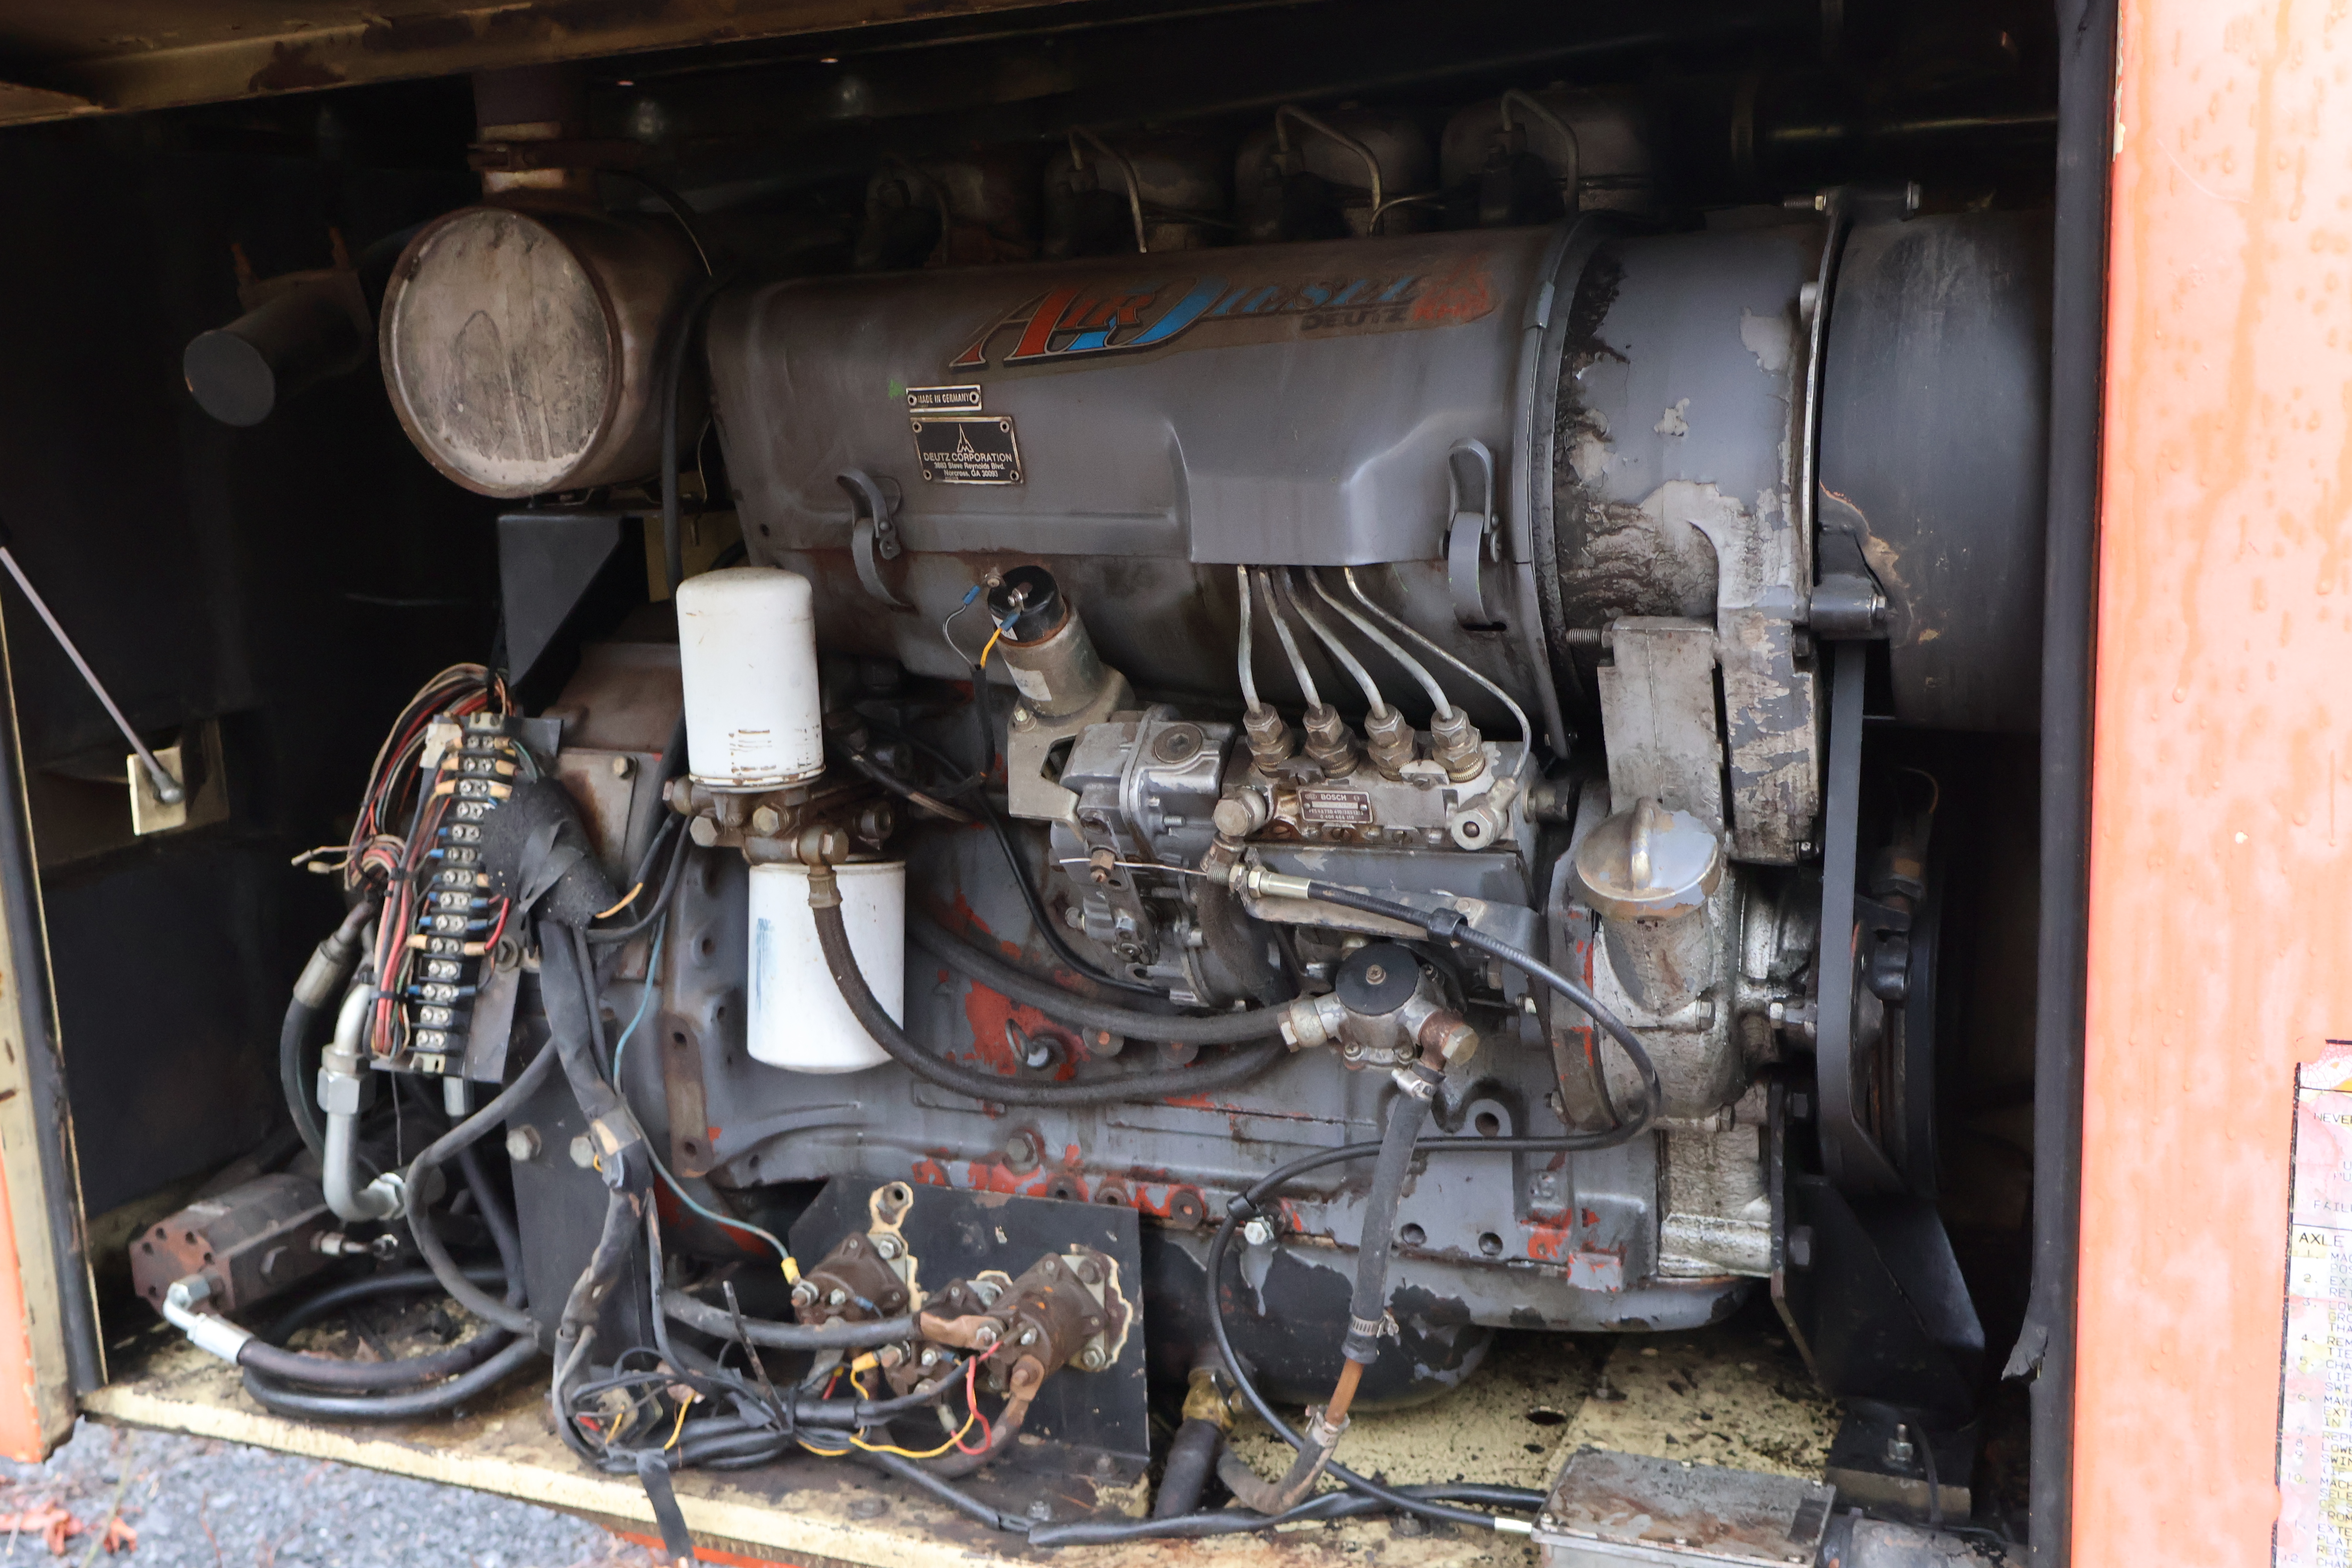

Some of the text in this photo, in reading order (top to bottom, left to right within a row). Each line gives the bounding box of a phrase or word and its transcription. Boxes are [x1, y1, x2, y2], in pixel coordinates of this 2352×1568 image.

[1299, 307, 1407, 331] DEUTZ
[918, 392, 970, 404] MADE IN GERMANY
[923, 452, 1013, 463] DEUTZ CORPORATION
[964, 462, 990, 471] Reynolds
[2314, 1112, 2352, 1125] NEVE
[2314, 1200, 2352, 1213] FAIL
[2299, 1232, 2345, 1247] AXLE
[2327, 1336, 2352, 1347] REM
[2327, 1347, 2352, 1359] TIE
[2326, 1359, 2352, 1371] CHA
[2324, 1395, 2352, 1408] MAK
[2323, 1406, 2352, 1418] EXT
[2325, 1417, 2340, 1427] IN
